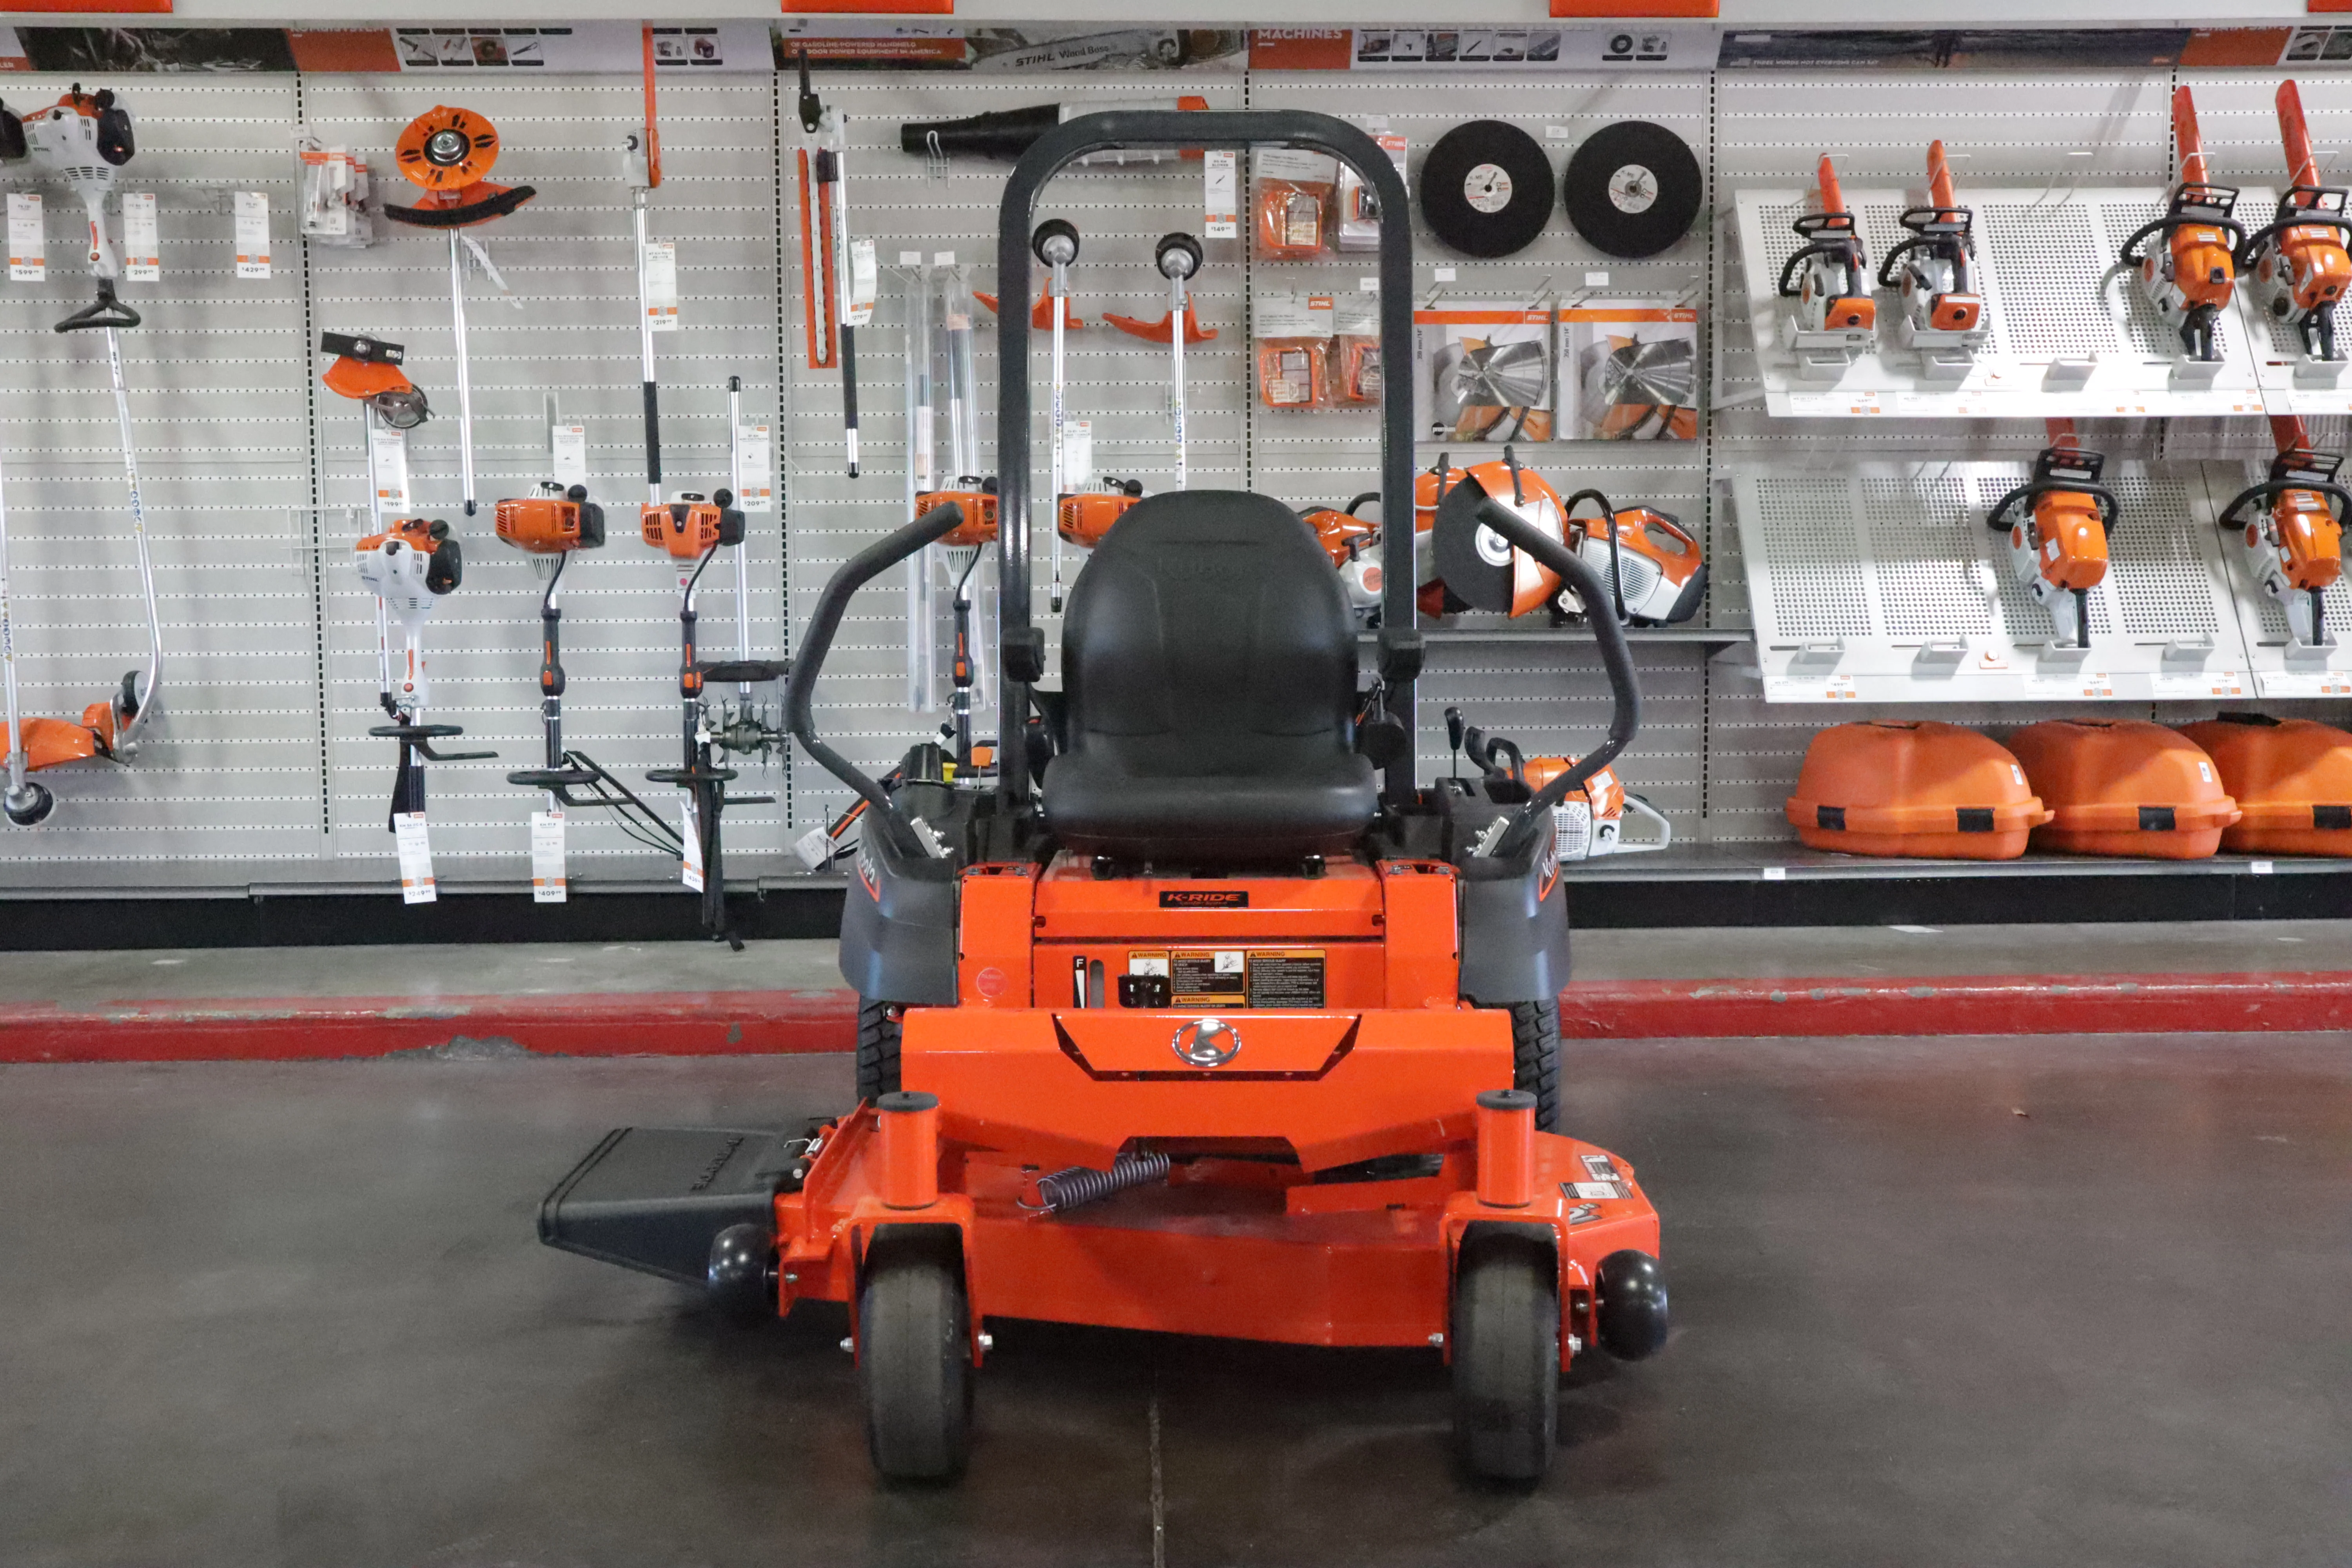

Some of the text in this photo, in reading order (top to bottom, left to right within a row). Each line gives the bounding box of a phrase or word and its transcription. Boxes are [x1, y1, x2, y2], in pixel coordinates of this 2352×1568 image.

[1258, 29, 1342, 39] MACHINES
[1015, 54, 1055, 66] STIHL
[1059, 47, 1086, 58] Wood
[1076, 958, 1084, 968] F
